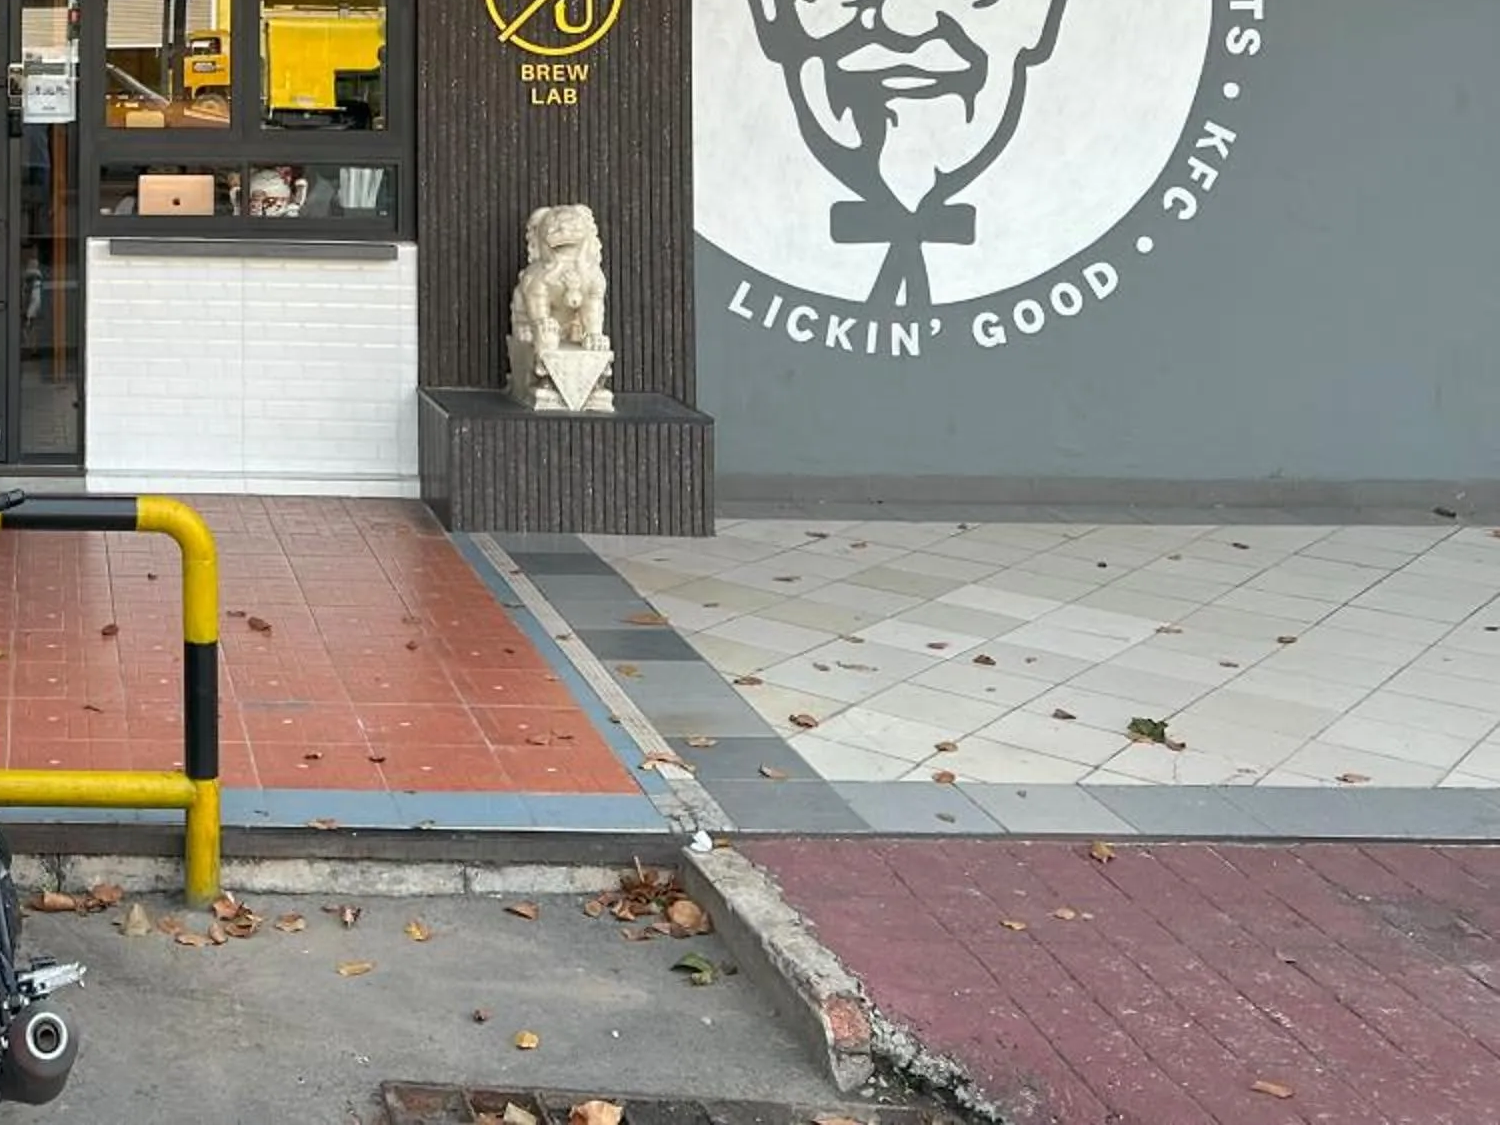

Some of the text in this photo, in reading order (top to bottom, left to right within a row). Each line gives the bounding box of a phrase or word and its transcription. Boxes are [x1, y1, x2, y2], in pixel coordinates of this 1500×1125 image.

[521, 64, 589, 81] BREW
[531, 88, 578, 104] LAB
[1163, 120, 1238, 222] KFC
[972, 261, 1120, 347] GOOD
